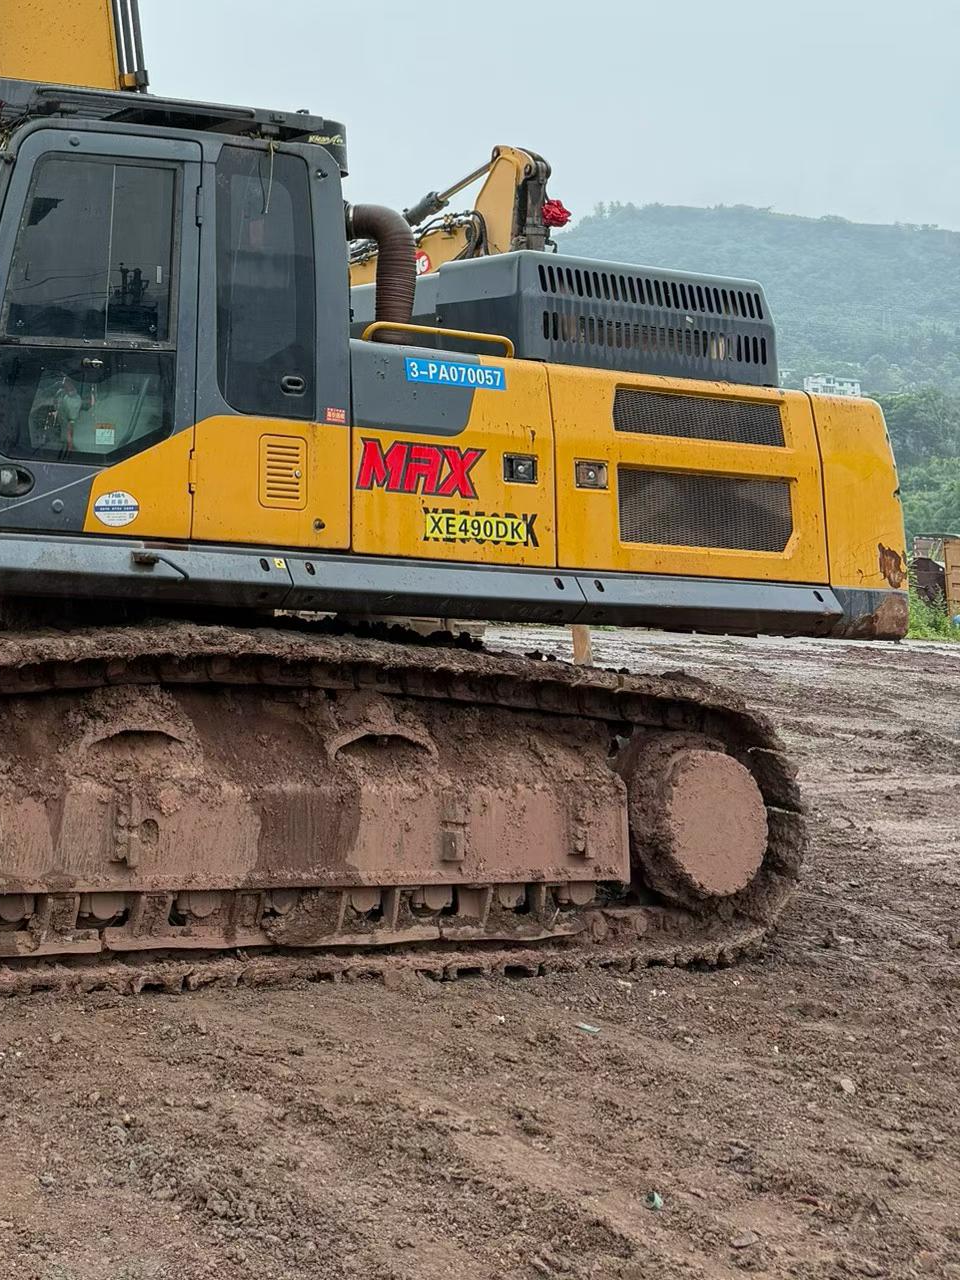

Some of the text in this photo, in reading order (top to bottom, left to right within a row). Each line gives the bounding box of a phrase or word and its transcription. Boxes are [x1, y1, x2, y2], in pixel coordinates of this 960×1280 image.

[409, 361, 502, 387] 3-PA070057
[355, 436, 487, 500] MAX
[429, 515, 523, 541] XE490DK
